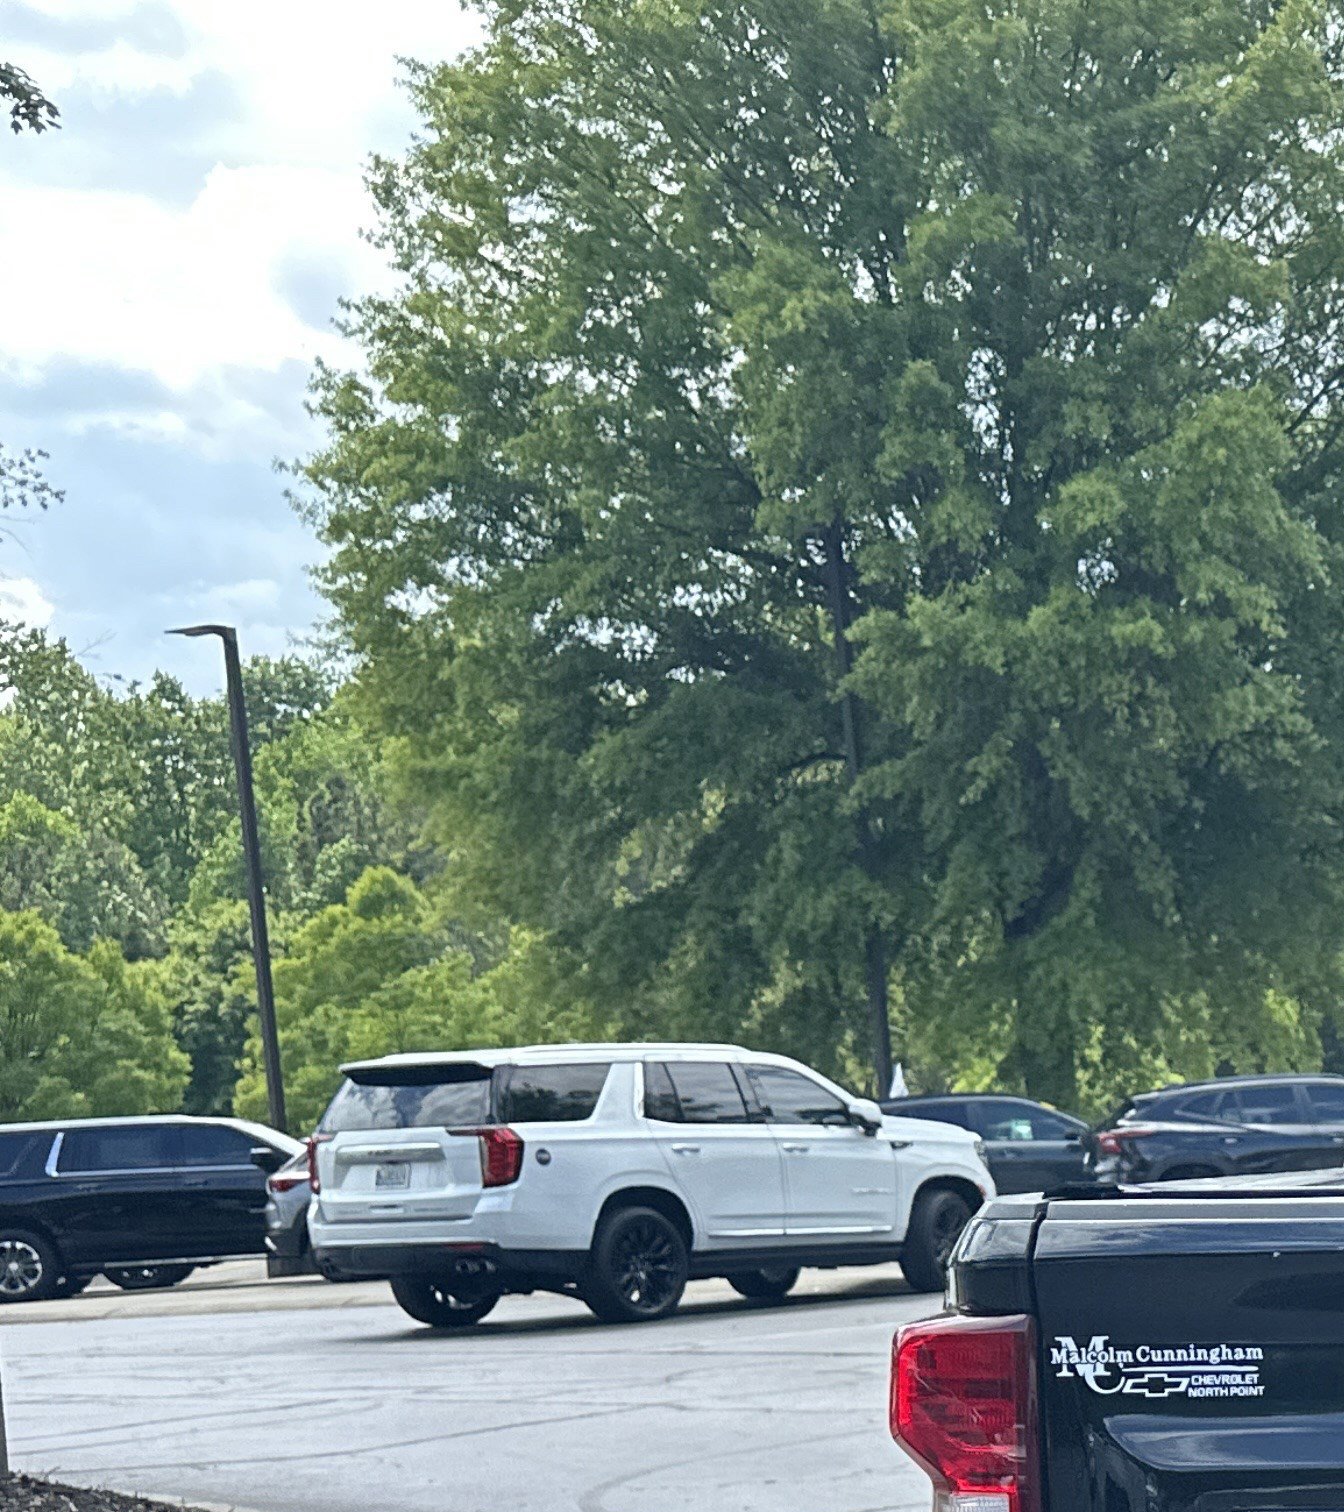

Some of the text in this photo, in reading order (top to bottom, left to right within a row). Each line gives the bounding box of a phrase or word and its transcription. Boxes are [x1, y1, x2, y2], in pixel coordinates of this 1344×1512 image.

[1050, 1343, 1264, 1366] Malcolm Cunningham
[1190, 1374, 1259, 1386] CHEVROLET
[1188, 1385, 1265, 1398] NORTH POINT
